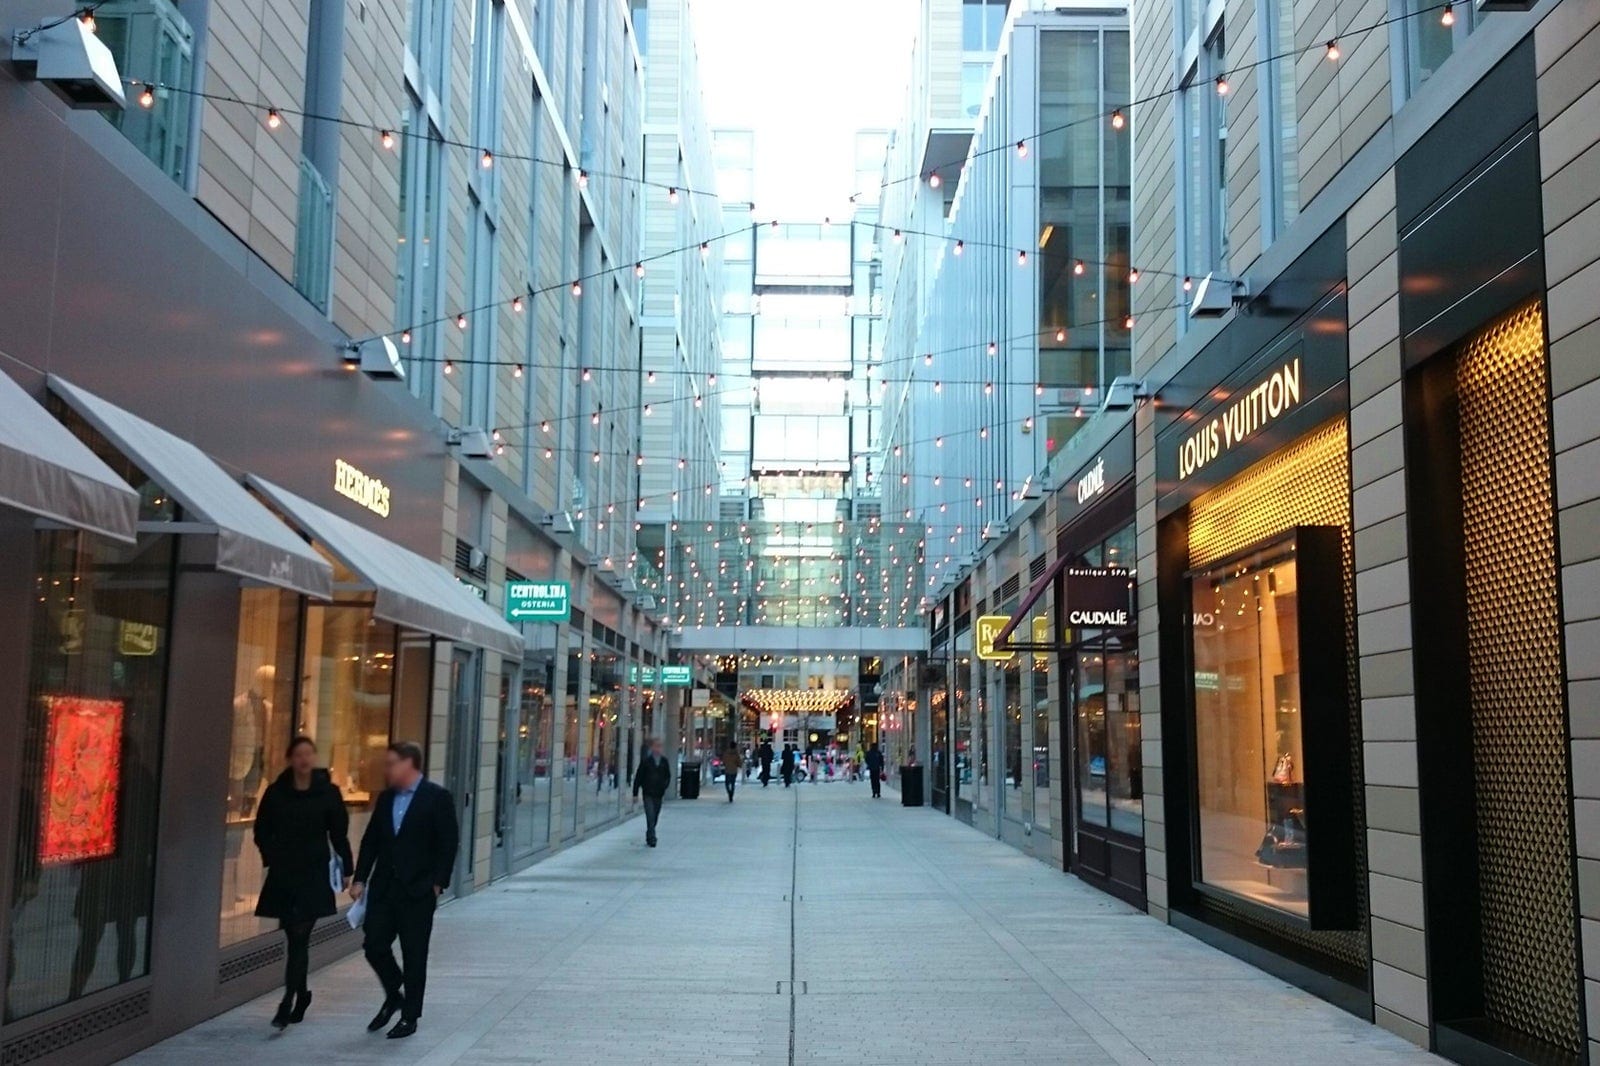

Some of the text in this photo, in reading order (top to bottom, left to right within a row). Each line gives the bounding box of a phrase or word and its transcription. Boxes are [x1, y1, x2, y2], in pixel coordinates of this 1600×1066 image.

[1179, 358, 1299, 480] LOUIS VUITTON
[1069, 568, 1126, 577] Boutique SPA
[510, 584, 567, 599] CENTROLINA
[521, 600, 556, 609] OSTERIA
